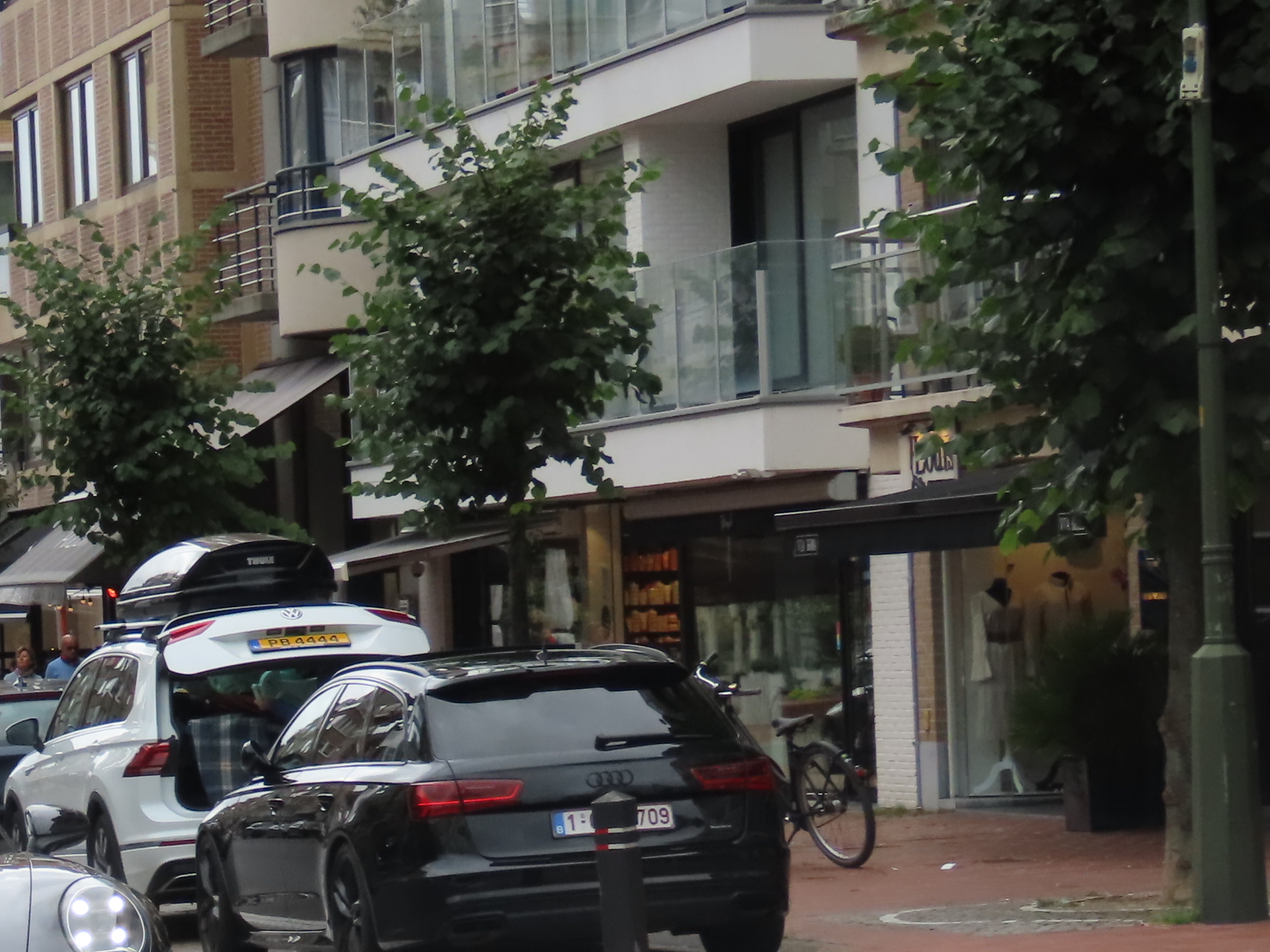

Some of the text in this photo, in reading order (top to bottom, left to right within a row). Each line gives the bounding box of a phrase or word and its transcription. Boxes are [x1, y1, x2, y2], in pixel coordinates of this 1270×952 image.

[268, 638, 291, 647] PB
[295, 635, 339, 645] 4444
[556, 825, 564, 834] B
